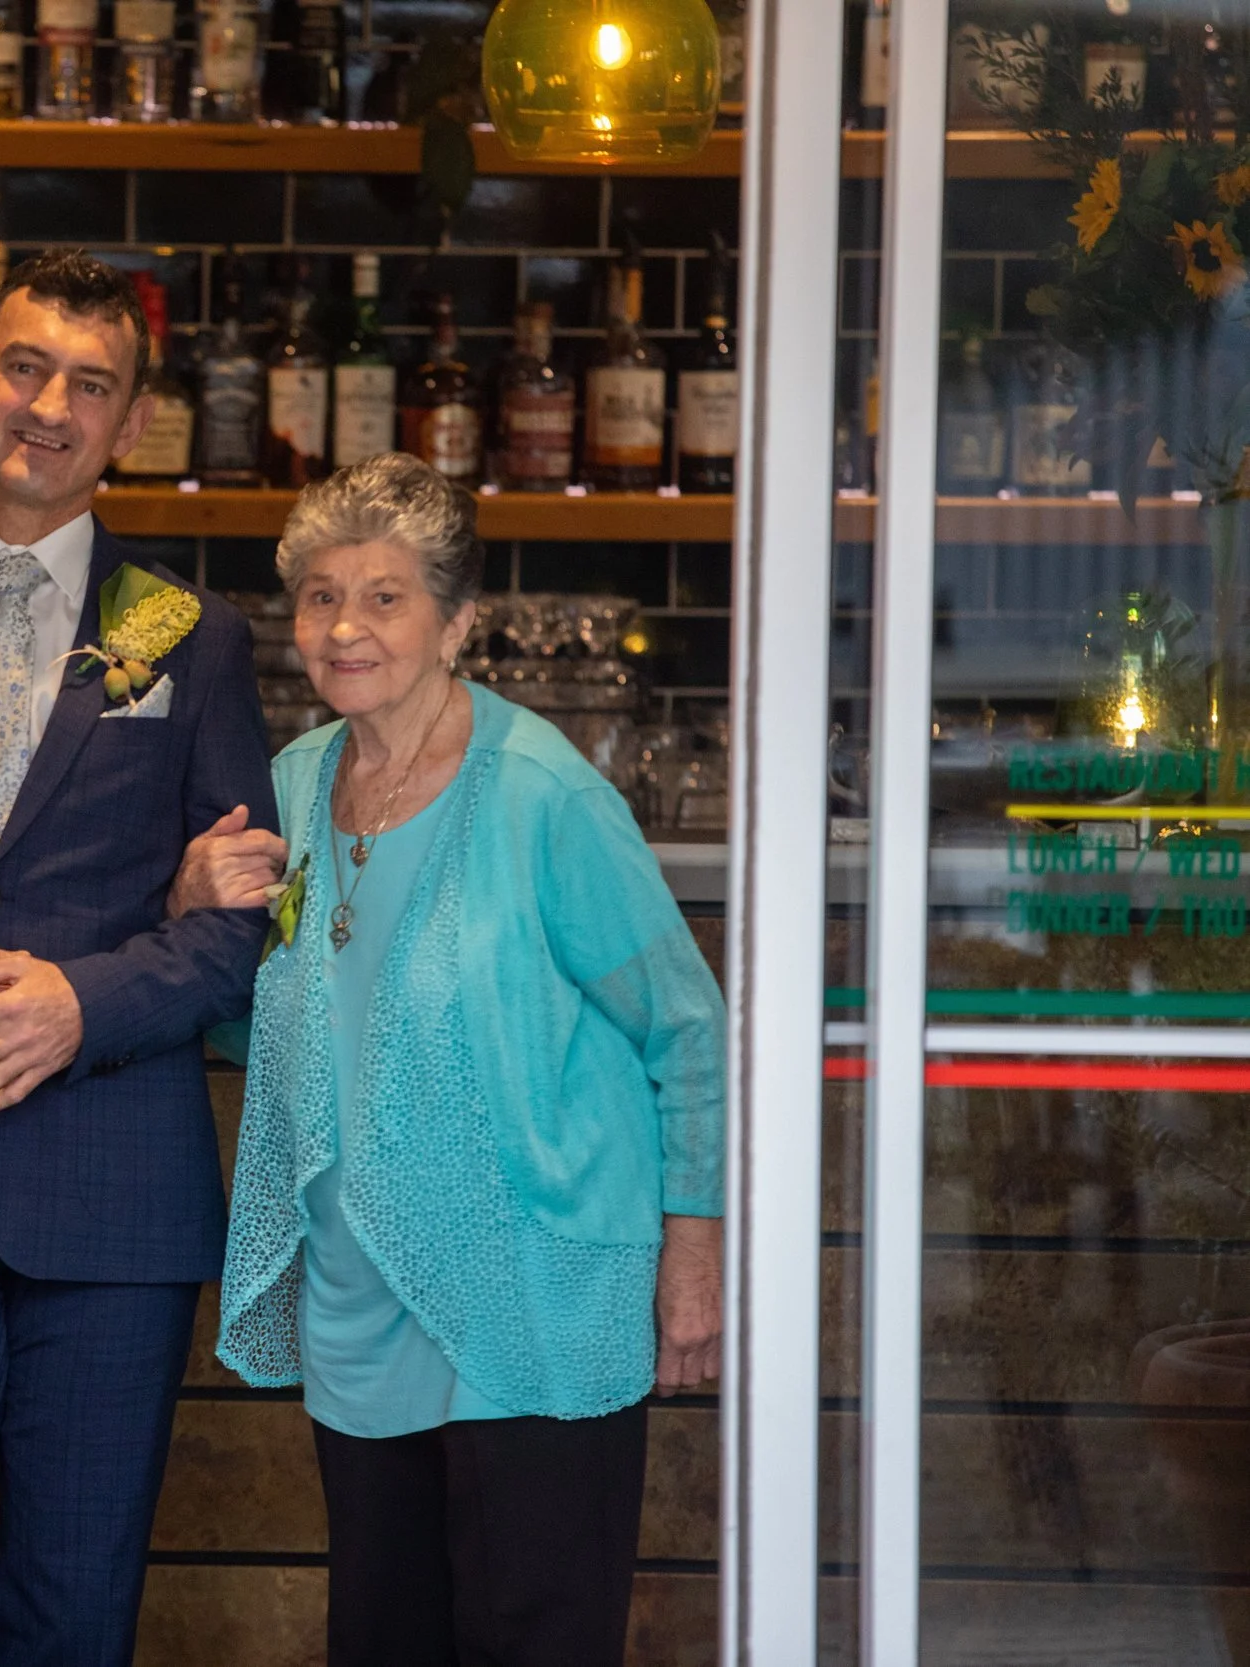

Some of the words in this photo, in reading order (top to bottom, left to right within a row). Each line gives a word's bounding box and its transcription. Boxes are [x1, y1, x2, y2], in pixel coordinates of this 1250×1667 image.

[1007, 831, 1117, 875] LUNCH
[1166, 837, 1240, 880] WED
[1007, 892, 1131, 936] DINNER
